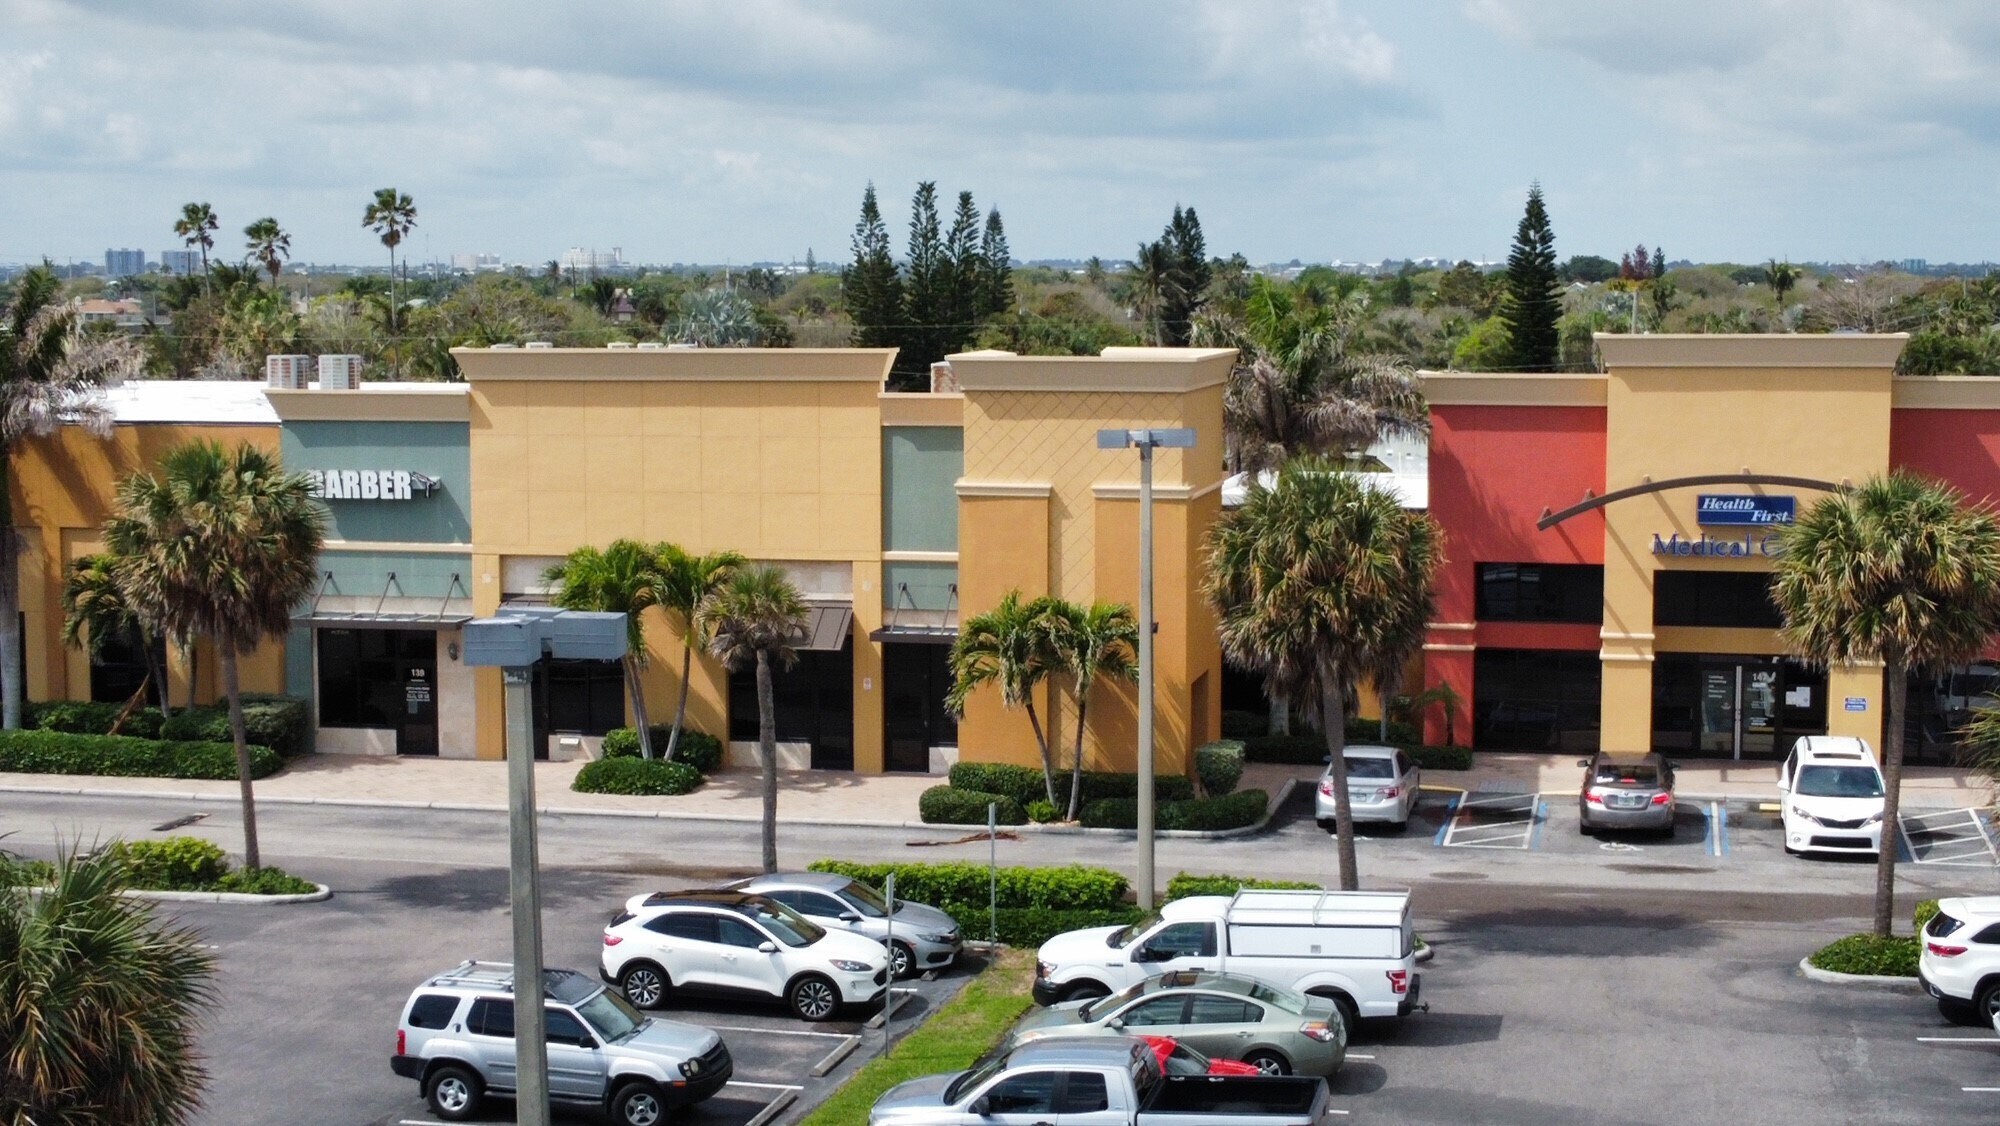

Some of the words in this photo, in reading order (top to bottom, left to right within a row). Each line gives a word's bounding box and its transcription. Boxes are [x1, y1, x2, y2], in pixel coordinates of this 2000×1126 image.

[1702, 497, 1755, 510] Health
[1751, 510, 1789, 522] First
[1652, 532, 1753, 557] Medical
